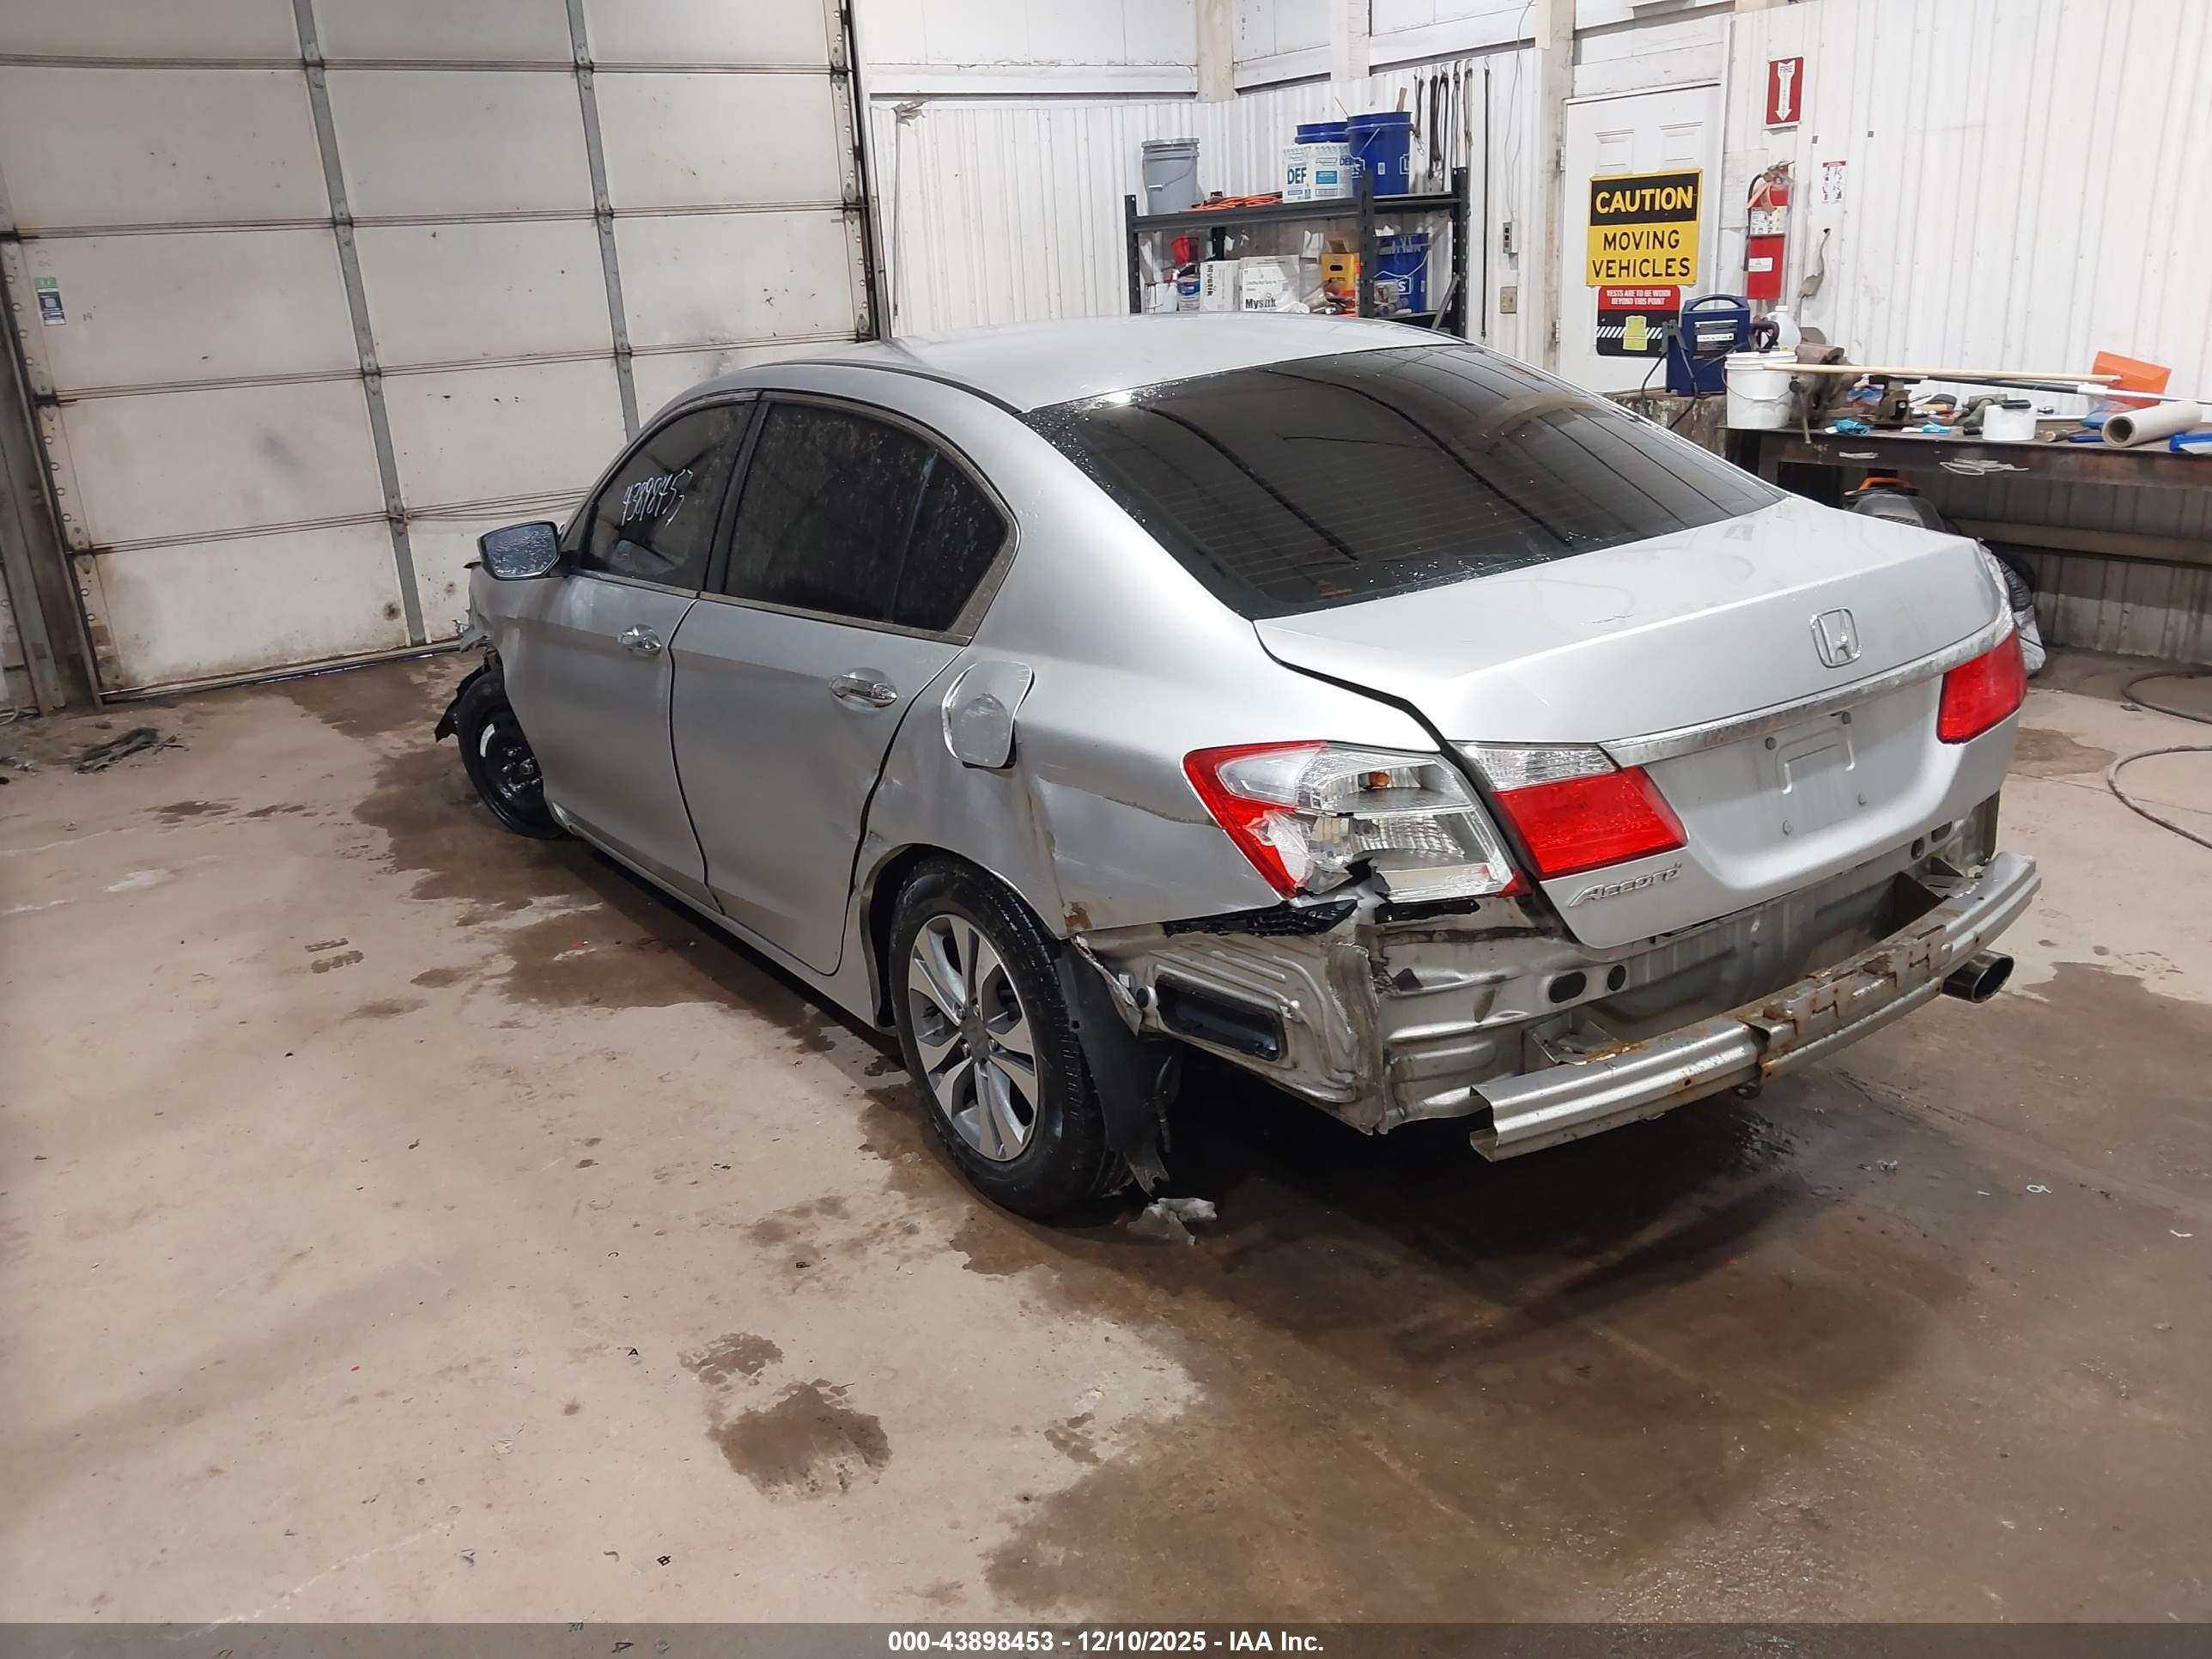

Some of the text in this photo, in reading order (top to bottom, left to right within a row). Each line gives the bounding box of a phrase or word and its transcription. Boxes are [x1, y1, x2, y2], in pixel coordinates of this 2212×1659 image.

[1287, 167, 1307, 185] DEF
[1595, 185, 1693, 214] CAUTION
[1603, 229, 1680, 251] MOVING
[1591, 258, 1691, 278] VEHICLES
[1567, 861, 1683, 908] Accord
